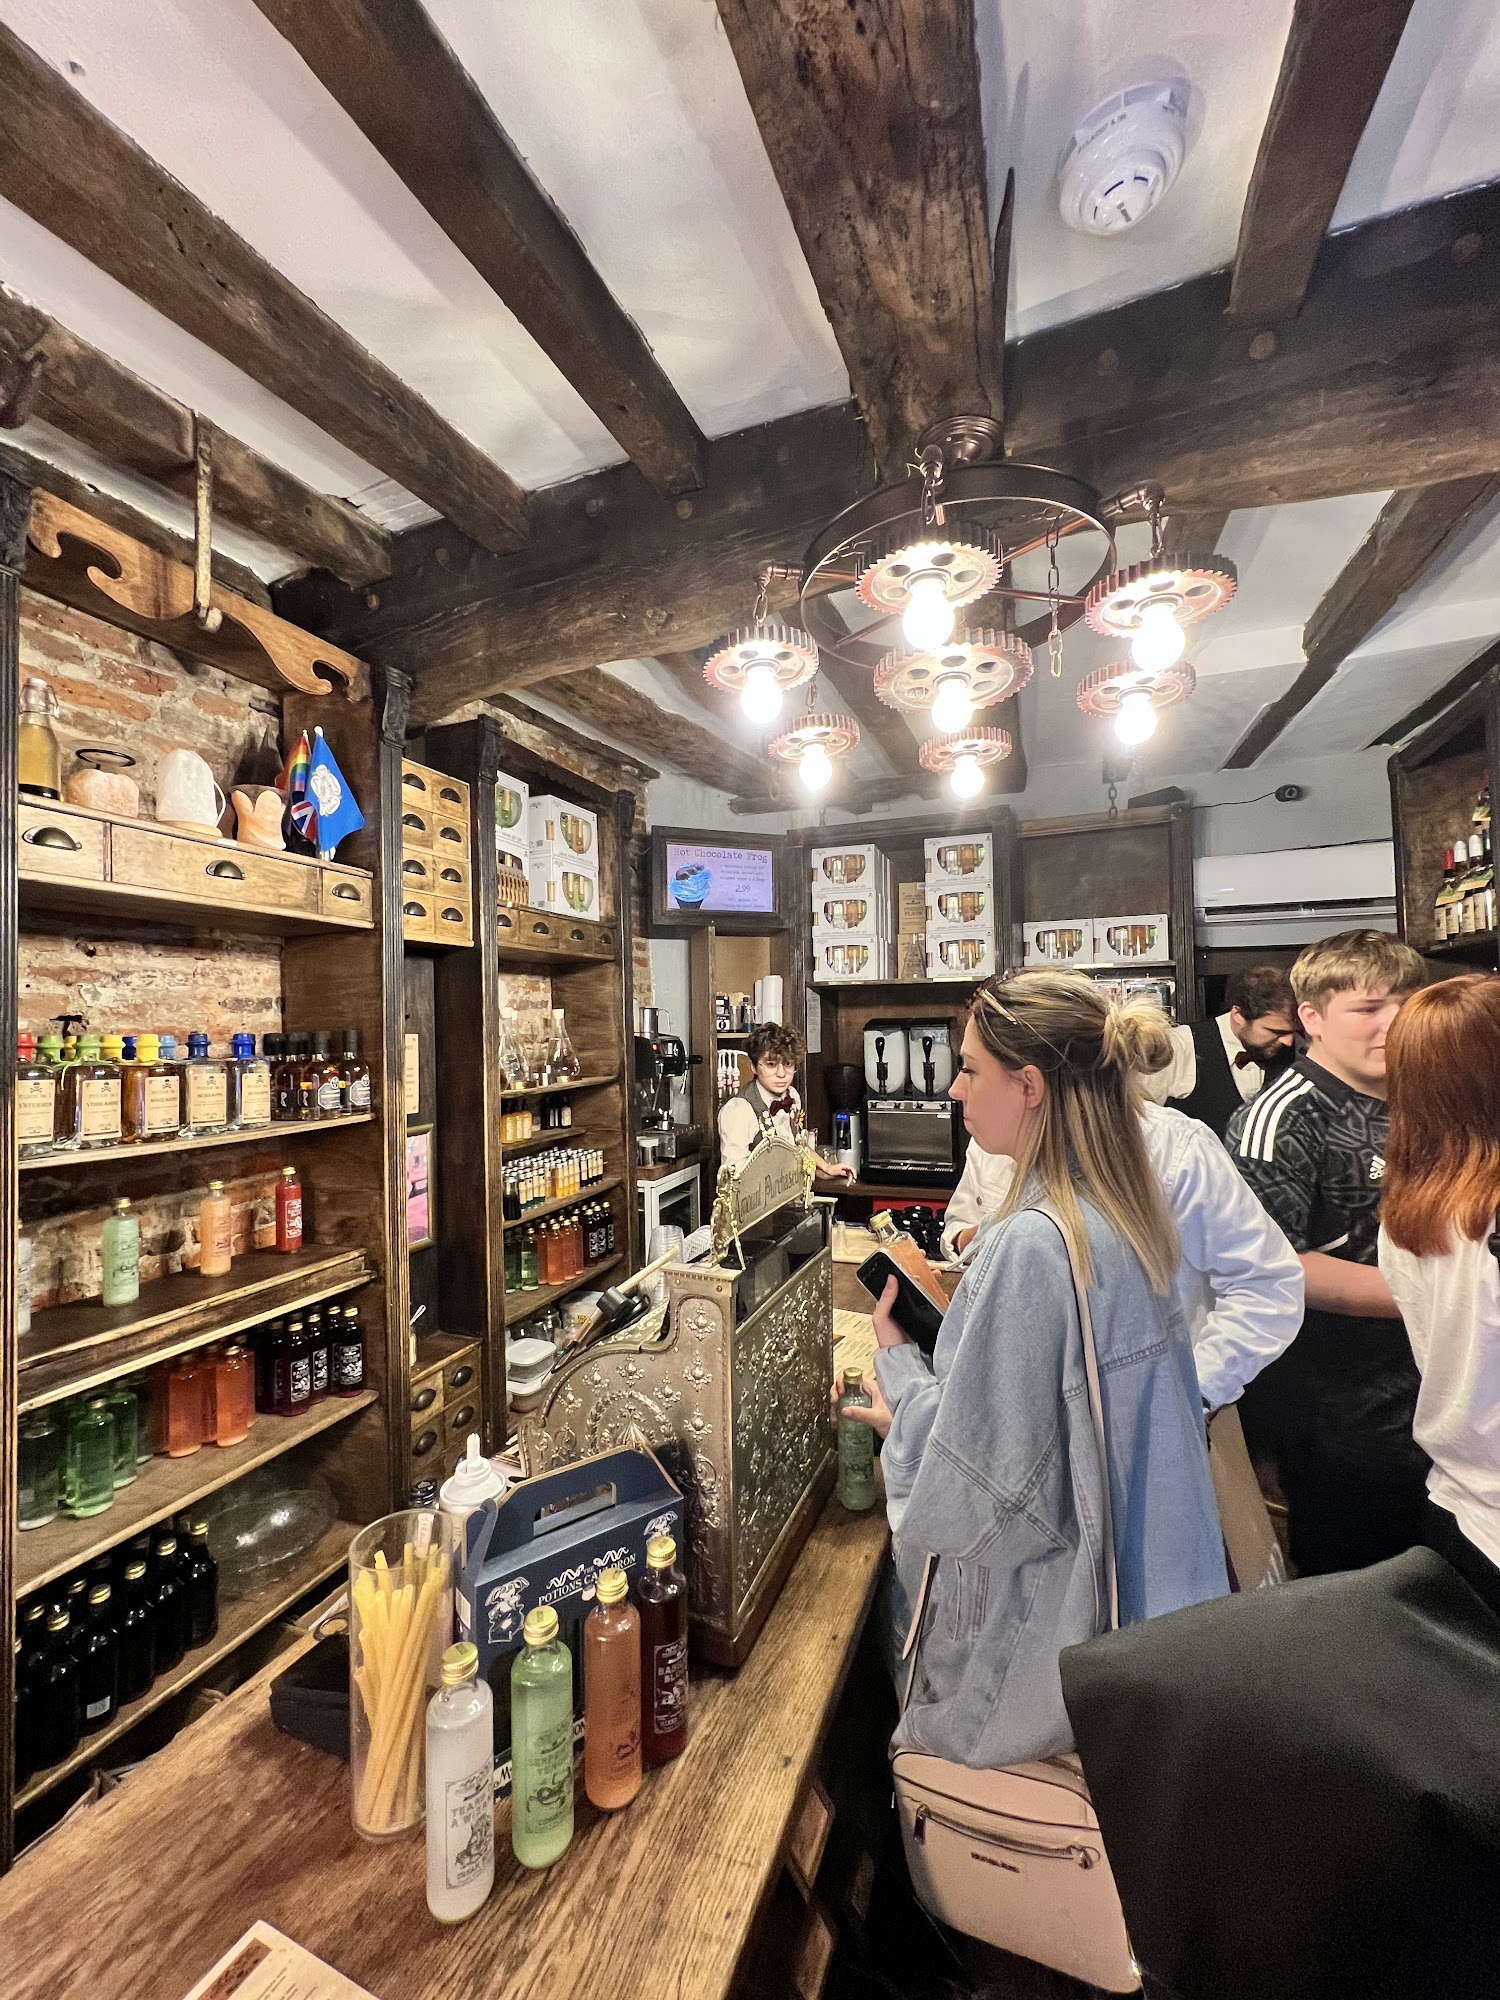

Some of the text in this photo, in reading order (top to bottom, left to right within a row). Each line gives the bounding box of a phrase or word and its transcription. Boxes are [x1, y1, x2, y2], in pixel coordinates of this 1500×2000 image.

[674, 847, 768, 864] Hot Chocolate Frog
[735, 884, 751, 893] 2.99
[538, 1577, 582, 1606] POTIONS
